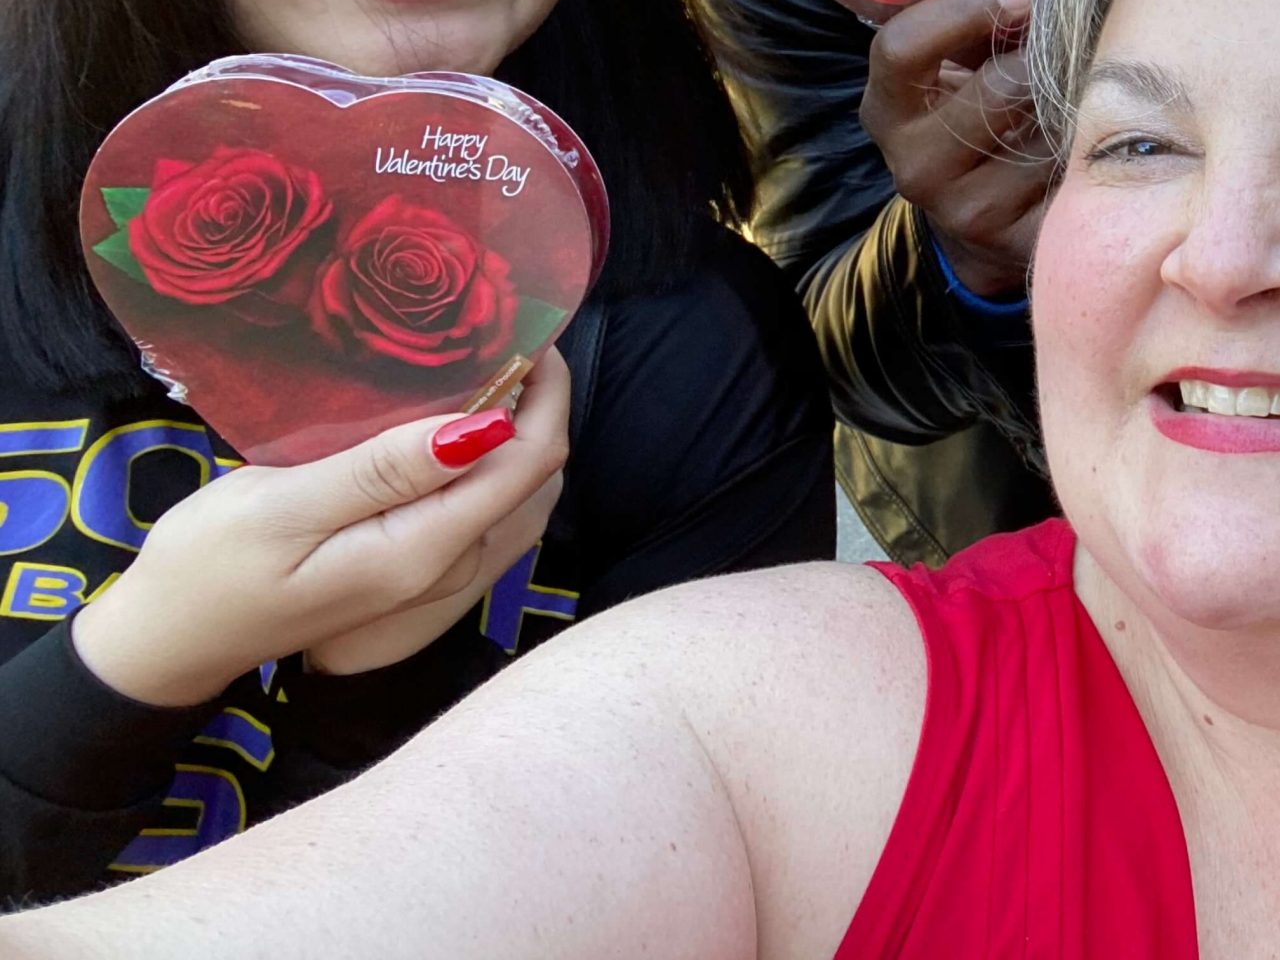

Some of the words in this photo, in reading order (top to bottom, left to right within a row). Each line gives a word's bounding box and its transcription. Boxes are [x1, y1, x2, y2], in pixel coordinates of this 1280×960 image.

[421, 124, 488, 161] Happy
[375, 147, 482, 182] Valentine's
[485, 154, 531, 197] Day
